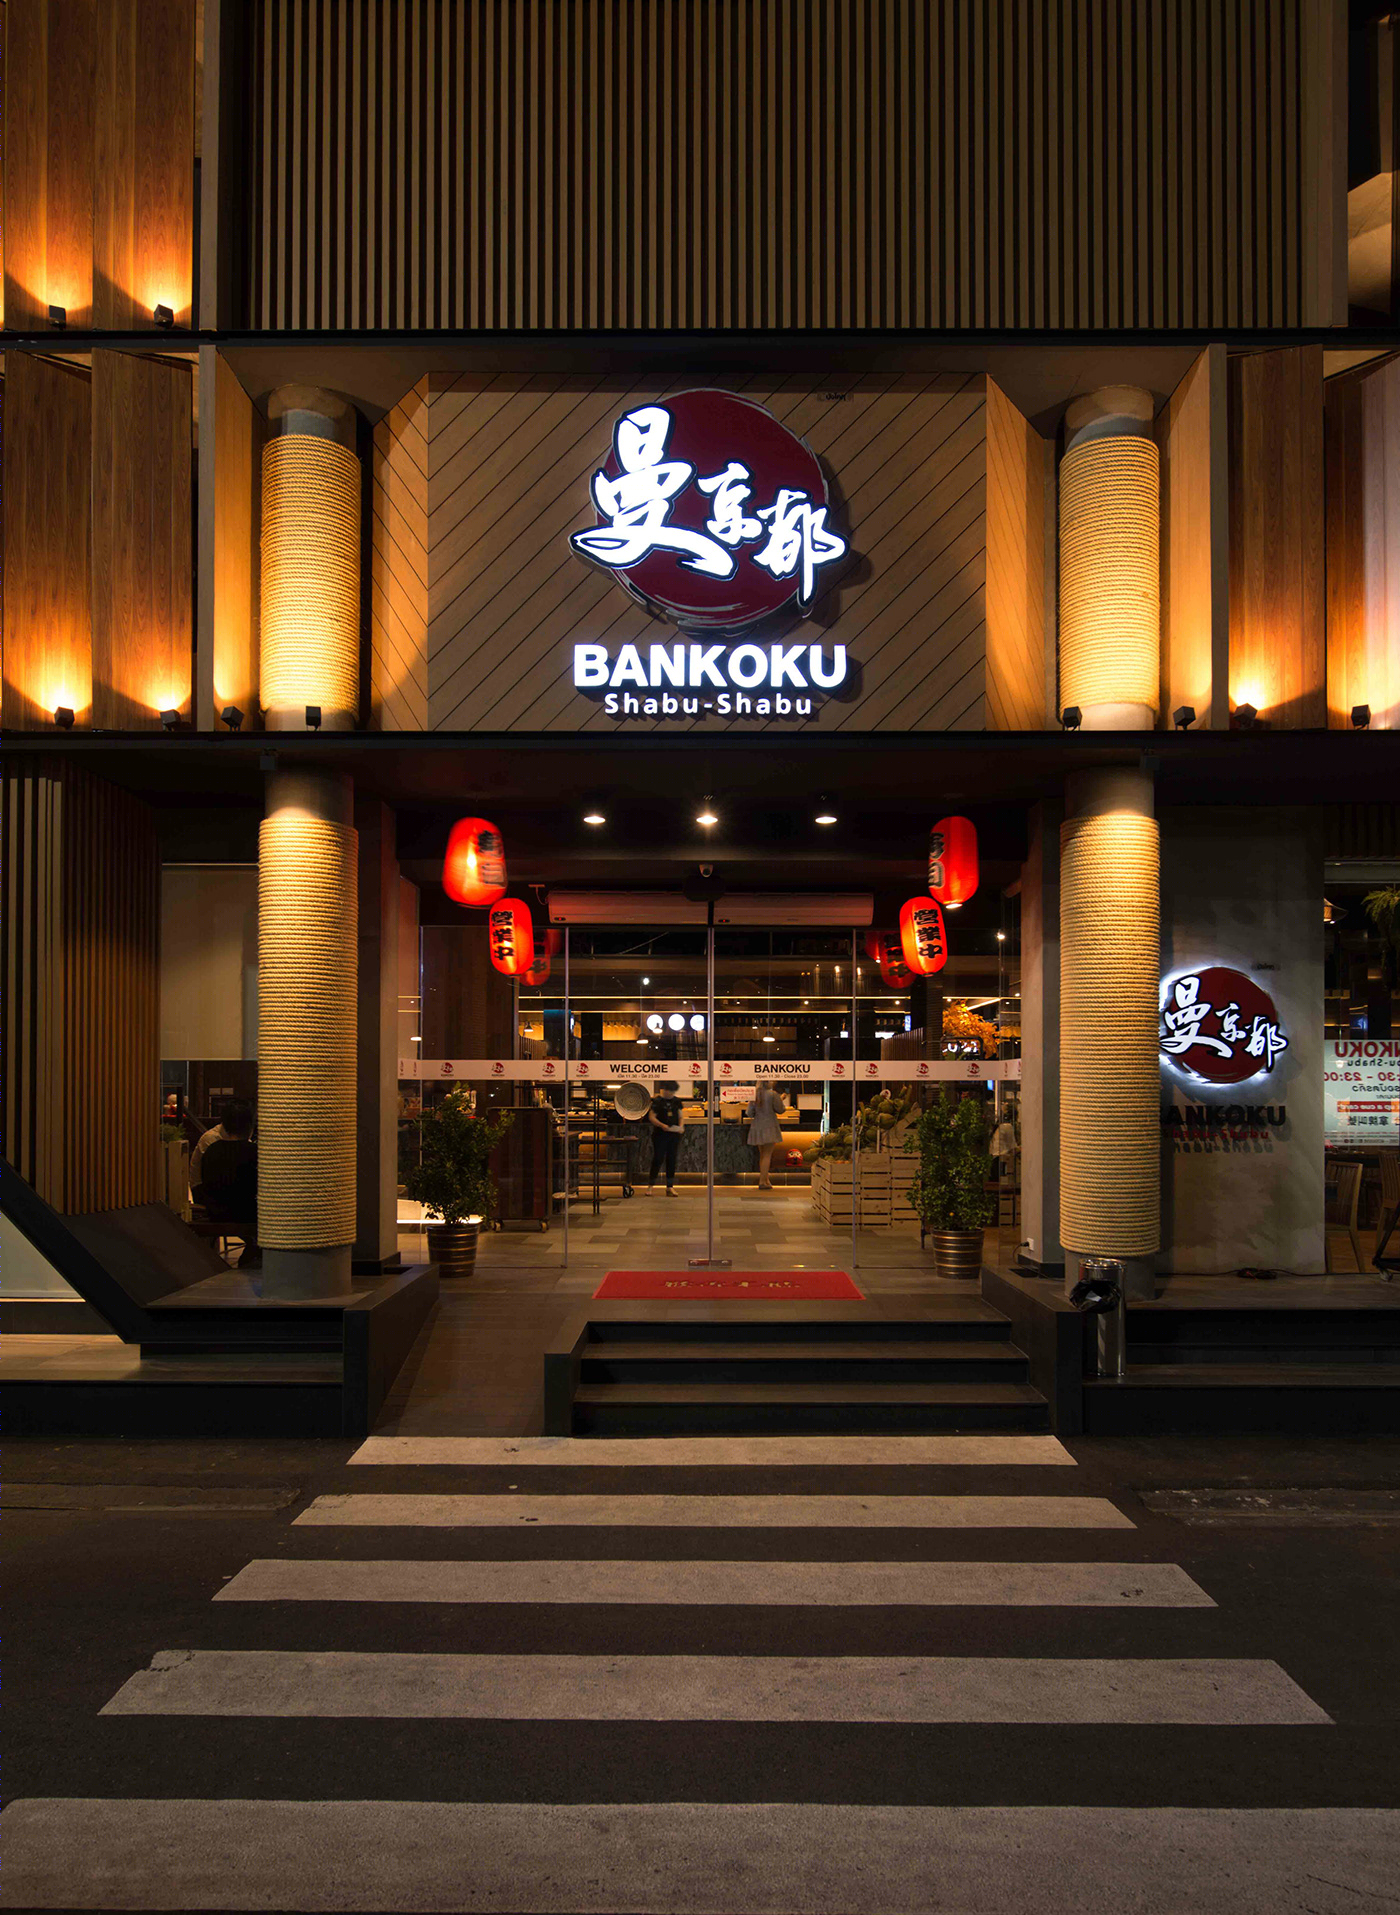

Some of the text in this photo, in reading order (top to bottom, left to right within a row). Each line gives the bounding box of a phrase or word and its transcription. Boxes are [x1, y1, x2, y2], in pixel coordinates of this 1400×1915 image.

[575, 406, 847, 601] 曼京都
[573, 643, 847, 689] BANKOKU
[604, 692, 812, 716] Shabu-Shabu
[1159, 975, 1289, 1069] 曼京都
[610, 1064, 668, 1073] WELCOME
[754, 1064, 811, 1073] BANKOKU
